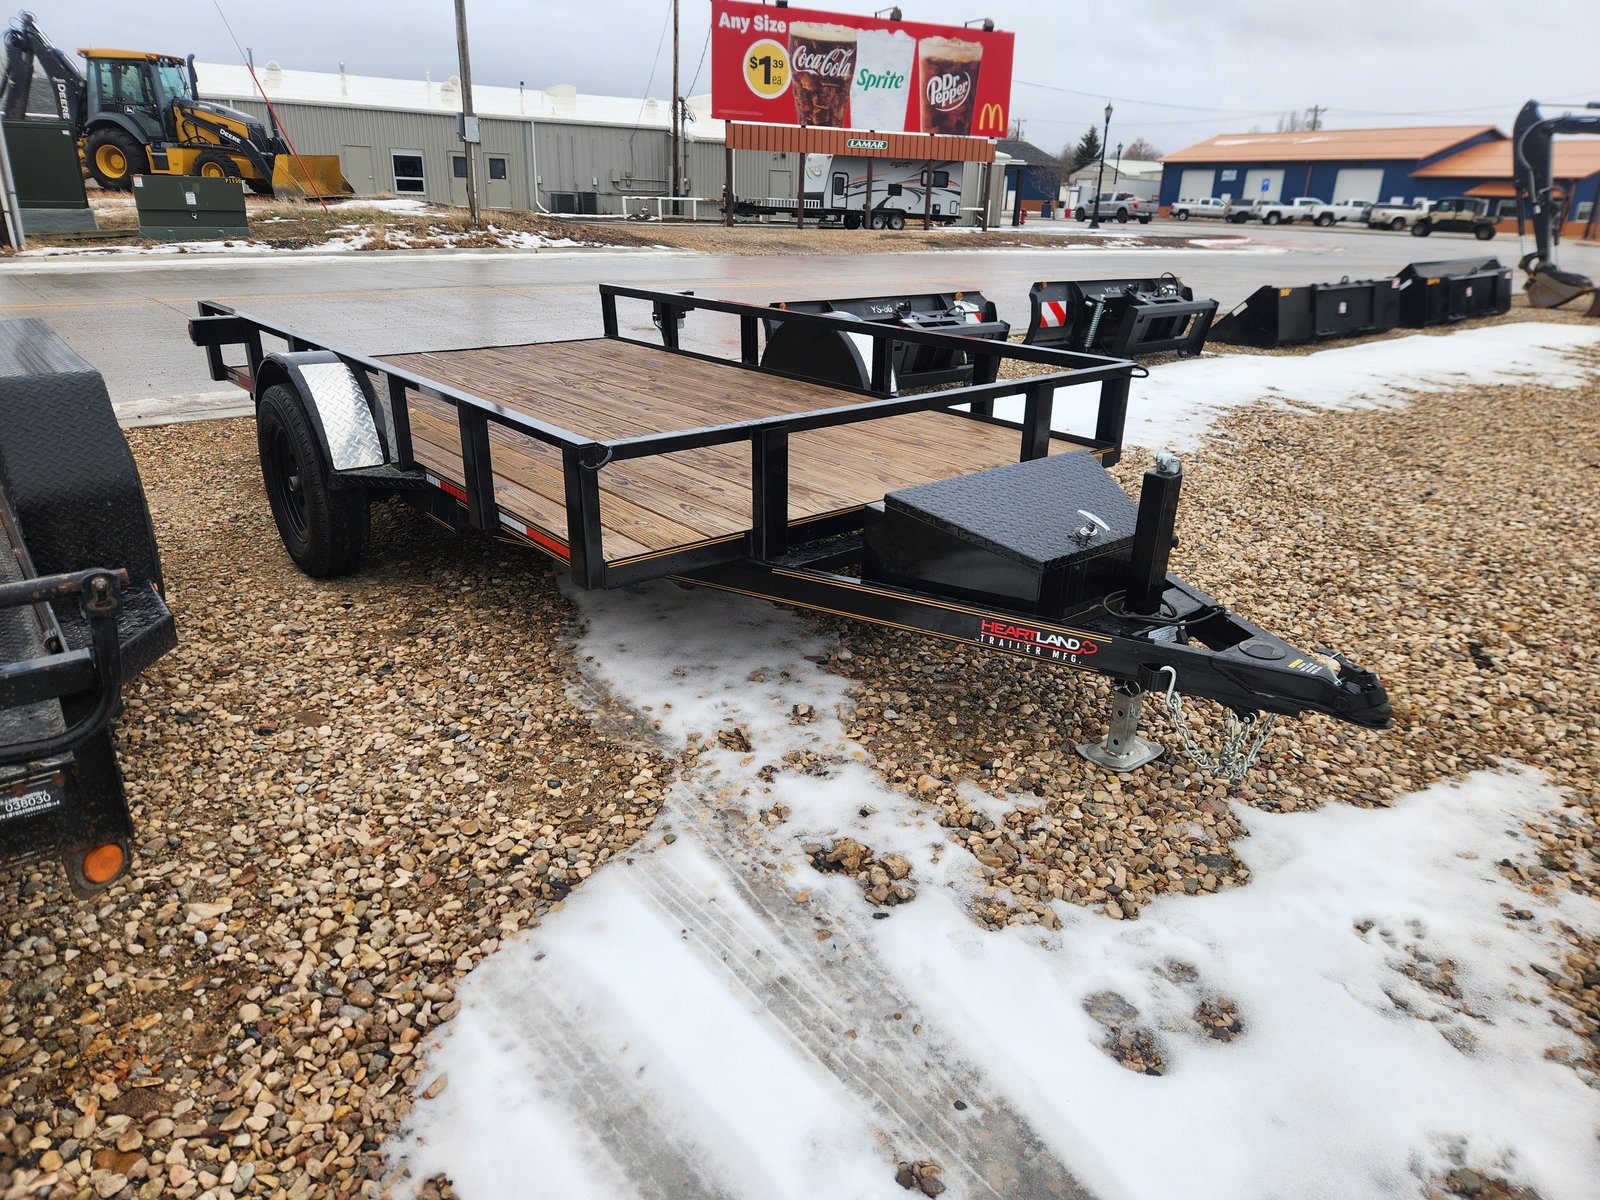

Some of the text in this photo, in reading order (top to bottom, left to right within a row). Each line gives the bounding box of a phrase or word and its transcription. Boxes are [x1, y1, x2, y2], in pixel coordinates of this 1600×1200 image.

[718, 11, 787, 34] Any Size
[792, 45, 854, 77] Coca-Cola
[856, 68, 904, 91] Sprite
[930, 75, 968, 107] Pepper
[942, 73, 960, 91] Dr
[56, 83, 70, 120] DEERE
[219, 128, 241, 144] DEERE
[850, 139, 885, 149] LAMAR
[980, 619, 1081, 650] HEARTLAND
[980, 634, 1082, 664] TRAILER MFG.
[5, 793, 51, 813] 038030
